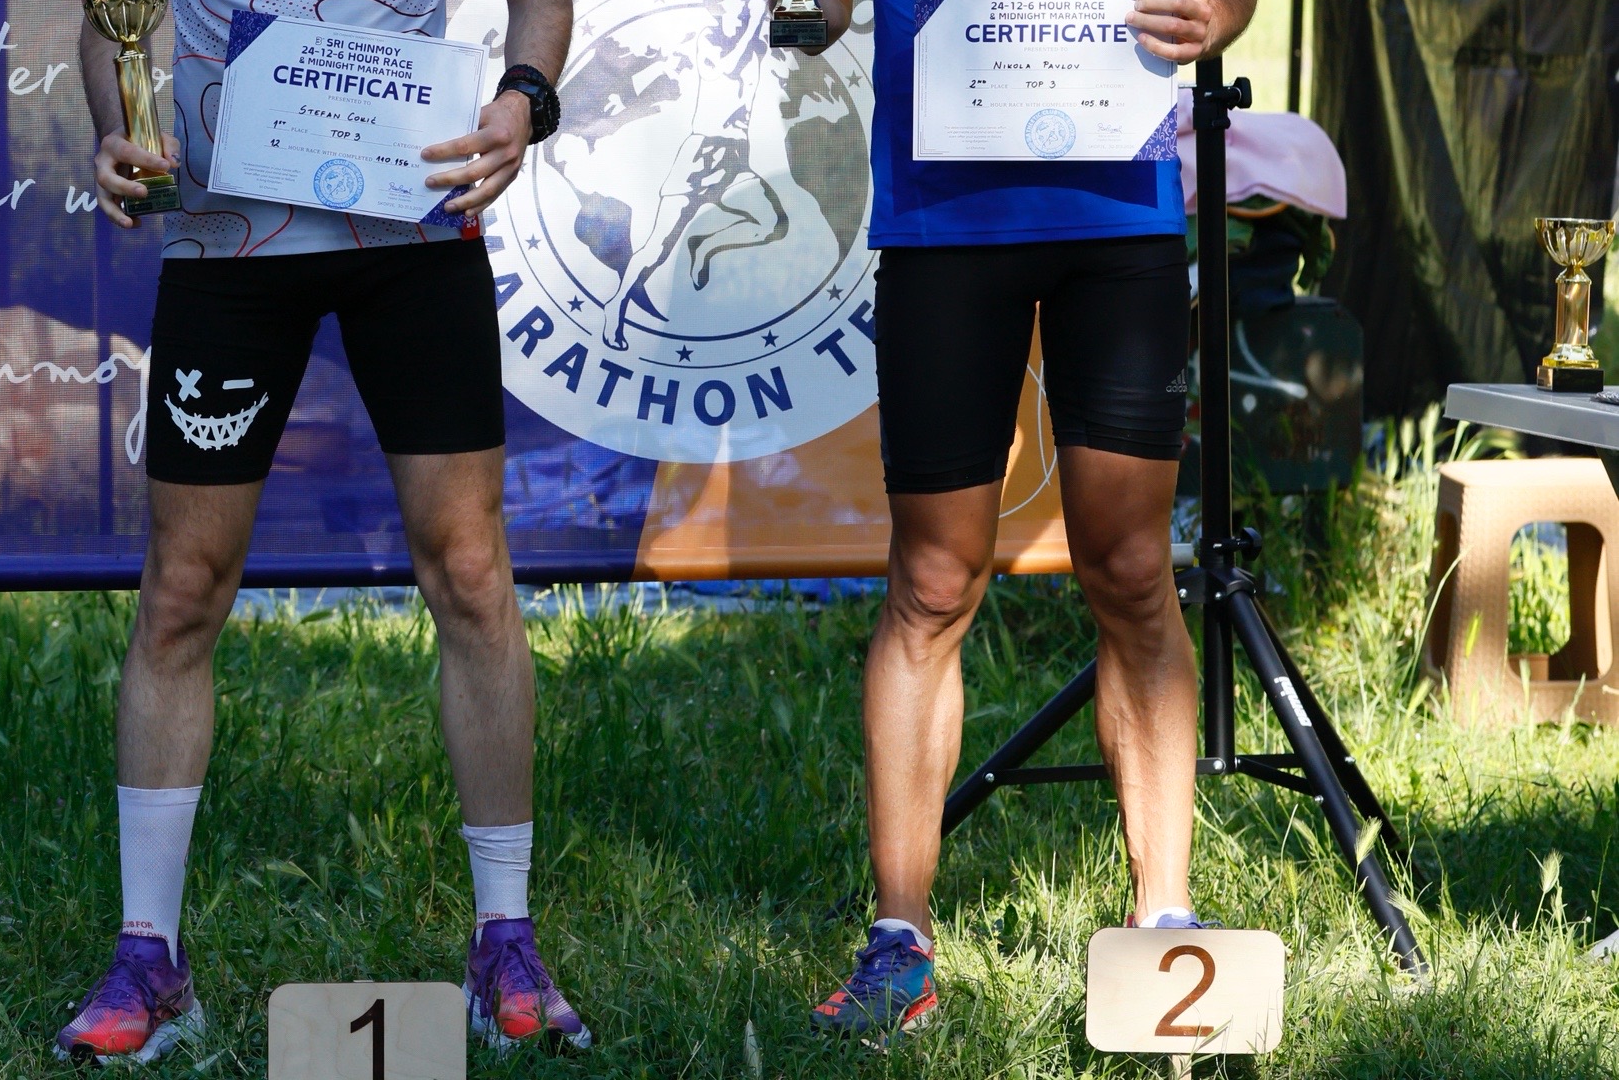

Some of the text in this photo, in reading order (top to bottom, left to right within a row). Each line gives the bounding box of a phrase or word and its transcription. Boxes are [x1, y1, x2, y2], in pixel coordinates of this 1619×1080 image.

[990, 1, 1105, 10] 24-12-6 HOUR RACE
[989, 12, 1106, 20] & MIDNIGHT MARATHON
[965, 24, 1128, 43] CERTIFICATE
[326, 38, 401, 57] SRI CHINMOY
[301, 45, 413, 70] 24-12-6 HOUR RACE
[298, 56, 412, 79] & MIDNIGHT MARATHON
[993, 60, 1081, 70] NIKOLA PAVLOV
[273, 65, 432, 105] CERTIFICATE
[1025, 80, 1056, 89] TOP 3
[328, 95, 362, 105] PRESENTED
[971, 98, 983, 107] 12
[330, 129, 361, 141] TOP 3
[270, 138, 281, 148] 12
[392, 142, 422, 151] CATEGORY
[305, 147, 320, 155] RACE
[321, 149, 337, 157] WITH
[338, 151, 373, 162] COMPLETED
[136, 921, 154, 929] FOR
[1154, 944, 1217, 1038] 2
[350, 998, 385, 1080] 1
